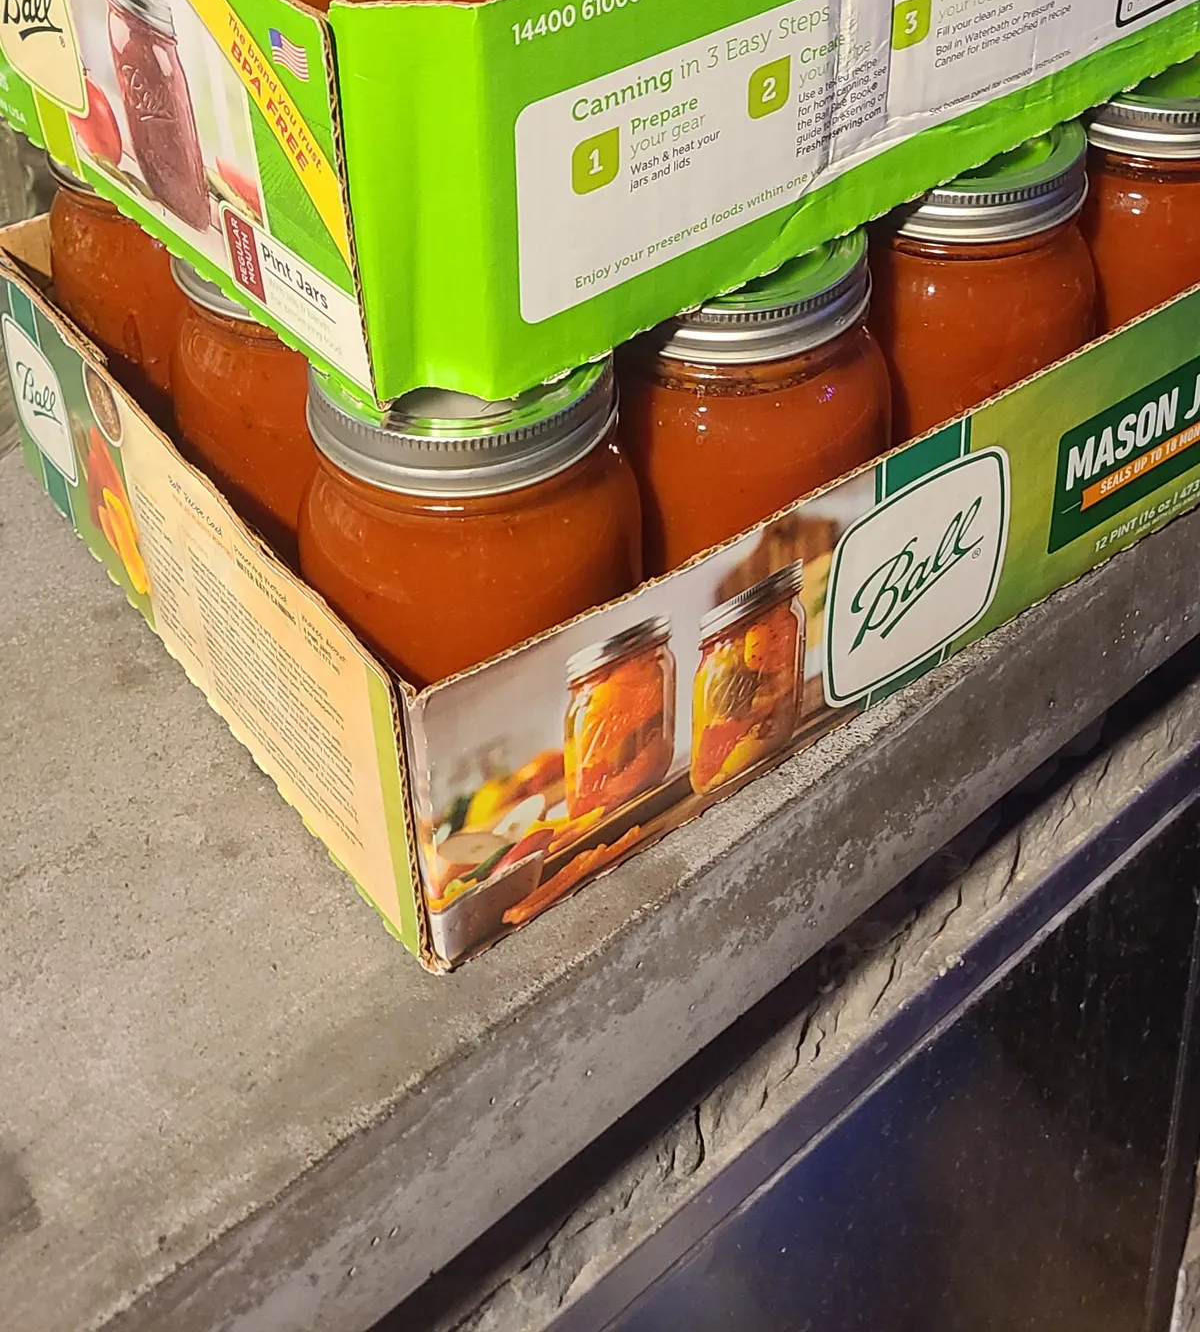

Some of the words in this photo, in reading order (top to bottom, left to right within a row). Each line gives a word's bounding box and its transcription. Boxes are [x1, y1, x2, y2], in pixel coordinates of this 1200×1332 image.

[512, 5, 576, 45] 14400
[904, 10, 918, 34] 3
[936, 26, 950, 38] Fill
[952, 18, 971, 35] your
[974, 8, 996, 24] clean
[998, 2, 1013, 17] jars
[936, 41, 952, 56] Boil
[954, 38, 963, 49] in
[965, 20, 1010, 46] Waterbath
[1012, 15, 1022, 26] or
[1023, 0, 1056, 22] Pressure
[937, 0, 969, 23] your
[1127, 2, 1133, 12] 0
[800, 34, 845, 64] Create
[934, 51, 965, 69] Canner
[967, 43, 980, 55] for
[981, 36, 1000, 50] time
[1002, 20, 1039, 46] specified
[1040, 16, 1047, 25] in
[1048, 3, 1072, 22] recipe
[572, 68, 673, 121] Canning
[680, 59, 700, 80] in
[707, 46, 719, 68] 3
[727, 29, 772, 61] Easy
[779, 6, 830, 40] Steps
[798, 91, 816, 104] Use
[818, 86, 824, 95] a
[852, 58, 878, 79] recipe
[799, 61, 830, 88] your
[228, 13, 245, 43] The
[247, 44, 277, 93] brand
[278, 95, 297, 128] you
[298, 127, 322, 173] trust.
[231, 42, 262, 98] BPA
[266, 97, 309, 171] FREE
[762, 78, 776, 102] 2
[798, 104, 812, 117] for
[813, 92, 836, 113] home
[873, 66, 887, 79] see
[630, 130, 668, 159] your
[672, 115, 706, 142] gear
[631, 98, 698, 135] Prepare
[797, 126, 822, 146] guide
[831, 98, 876, 127] preserving
[797, 117, 812, 131] the
[588, 148, 604, 175] 1
[630, 155, 660, 175] Wash
[663, 151, 669, 162] &
[673, 141, 694, 158] heat
[697, 129, 720, 149] your
[630, 177, 649, 193] jars
[652, 164, 671, 181] and
[674, 156, 691, 172] lids
[230, 218, 250, 284] REGULAR
[575, 264, 611, 289] Enjoy
[615, 249, 644, 272] your
[647, 218, 708, 257] preserved
[712, 203, 743, 226] foods
[747, 184, 784, 210] within
[787, 174, 808, 190] one
[240, 232, 257, 284] MOUTH
[261, 242, 293, 282] Pint
[296, 270, 329, 310] Jars
[16, 361, 62, 425] Ball
[1065, 386, 1179, 491] MASON
[1100, 467, 1131, 494] SEALS
[1134, 457, 1150, 475] UP
[1150, 448, 1163, 464] TO
[1166, 441, 1177, 455] 18
[1095, 538, 1108, 553] 12
[1110, 517, 1138, 540] PINT
[1139, 505, 1156, 526] (16
[1158, 498, 1171, 513] oz
[1180, 478, 1200, 498] 473
[848, 496, 985, 655] Ball
